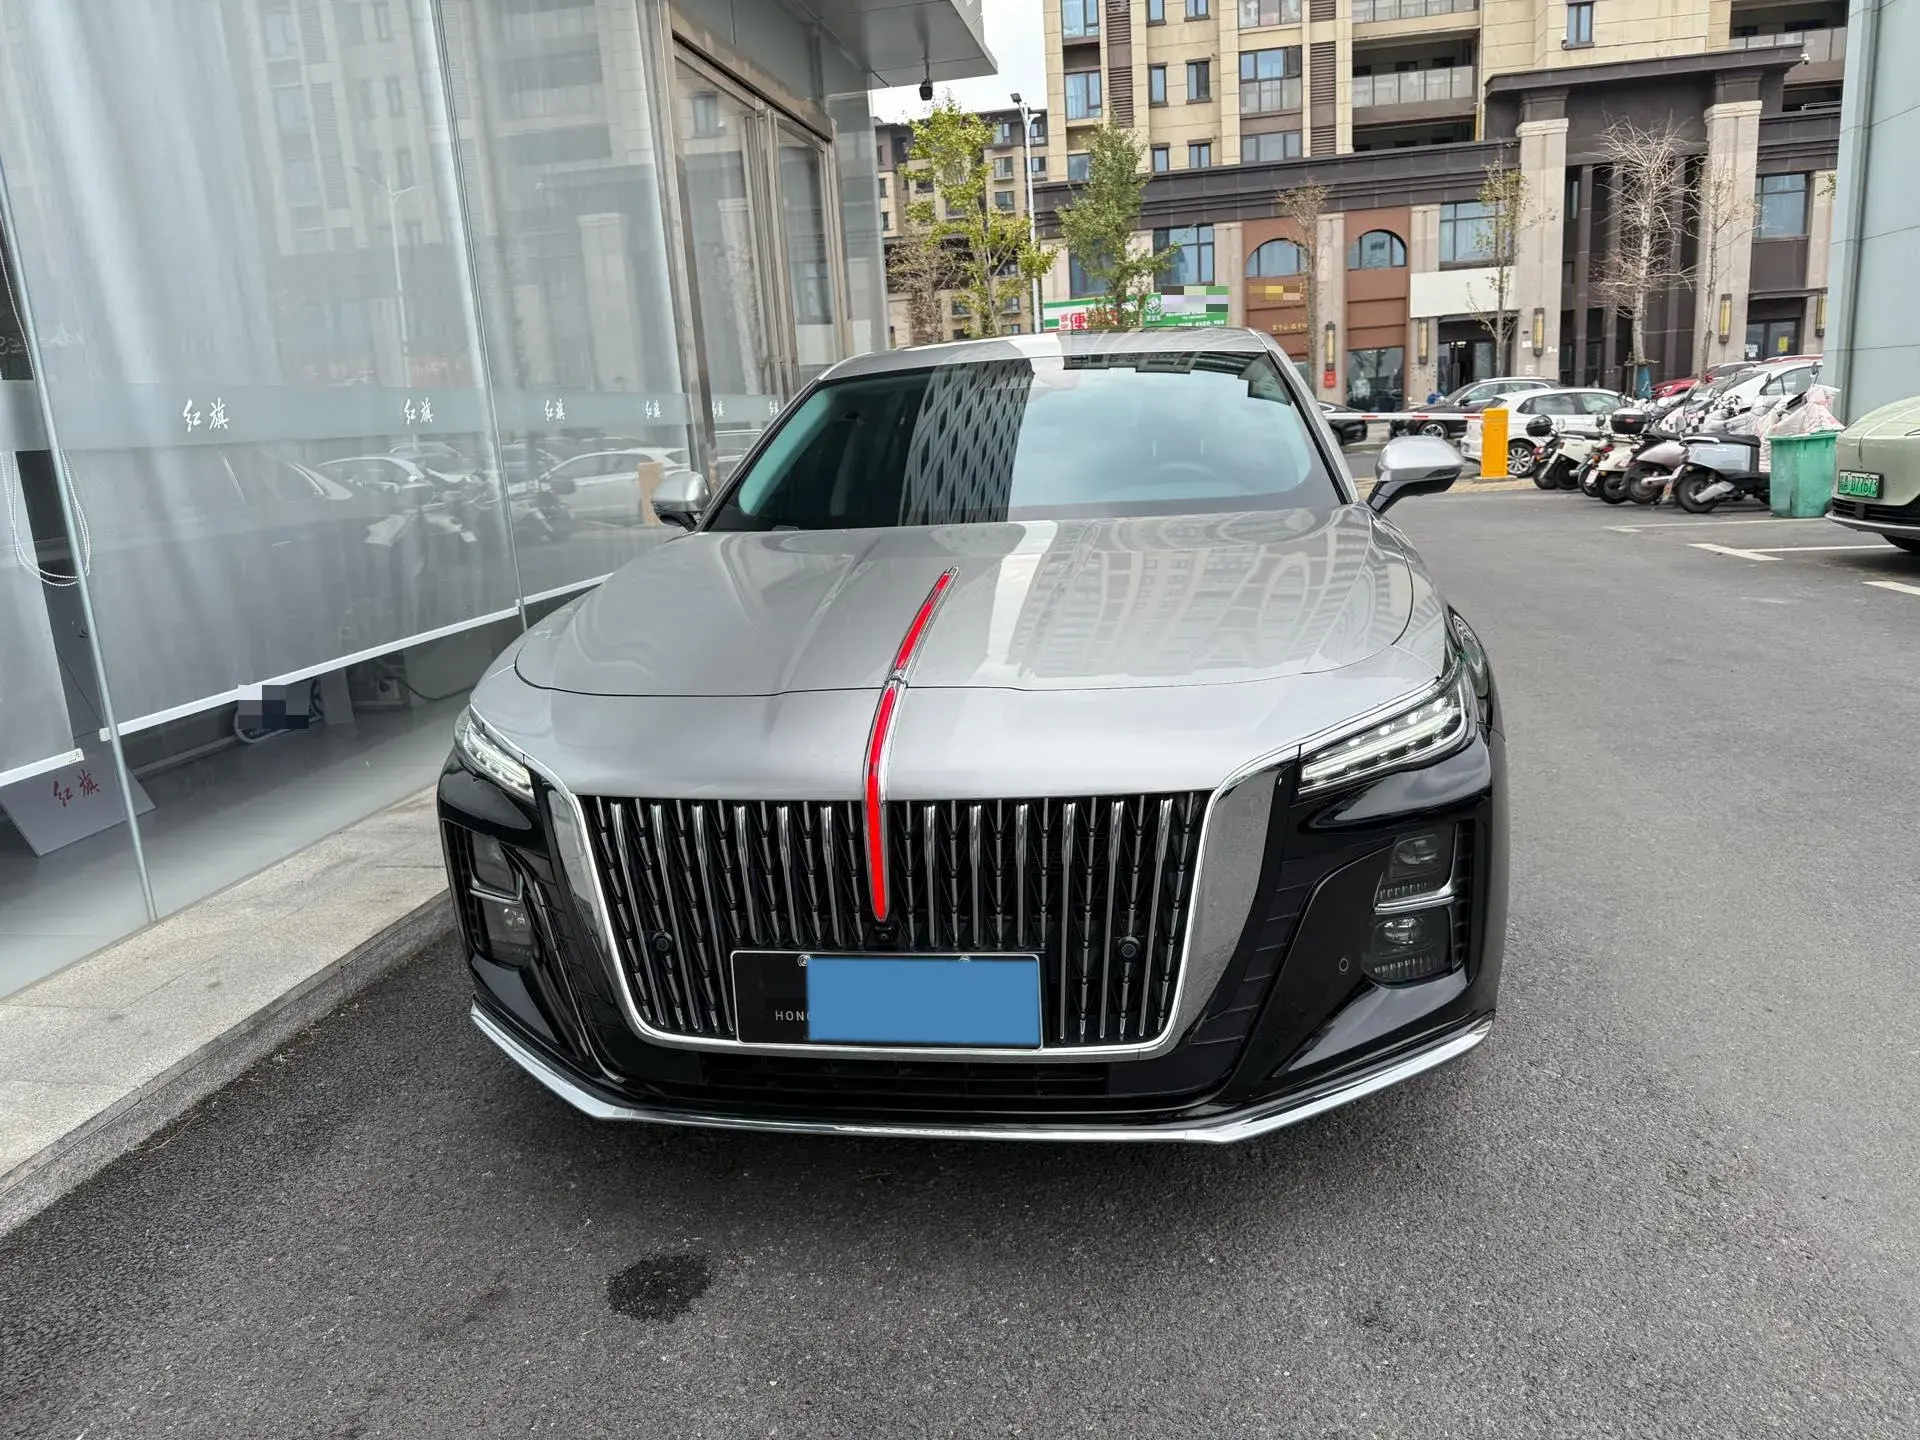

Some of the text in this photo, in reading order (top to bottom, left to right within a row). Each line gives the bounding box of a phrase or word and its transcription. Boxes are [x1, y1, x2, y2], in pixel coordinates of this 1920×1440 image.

[182, 396, 230, 433] 红旗
[403, 396, 434, 425] 红旗
[52, 768, 101, 808] 红旗
